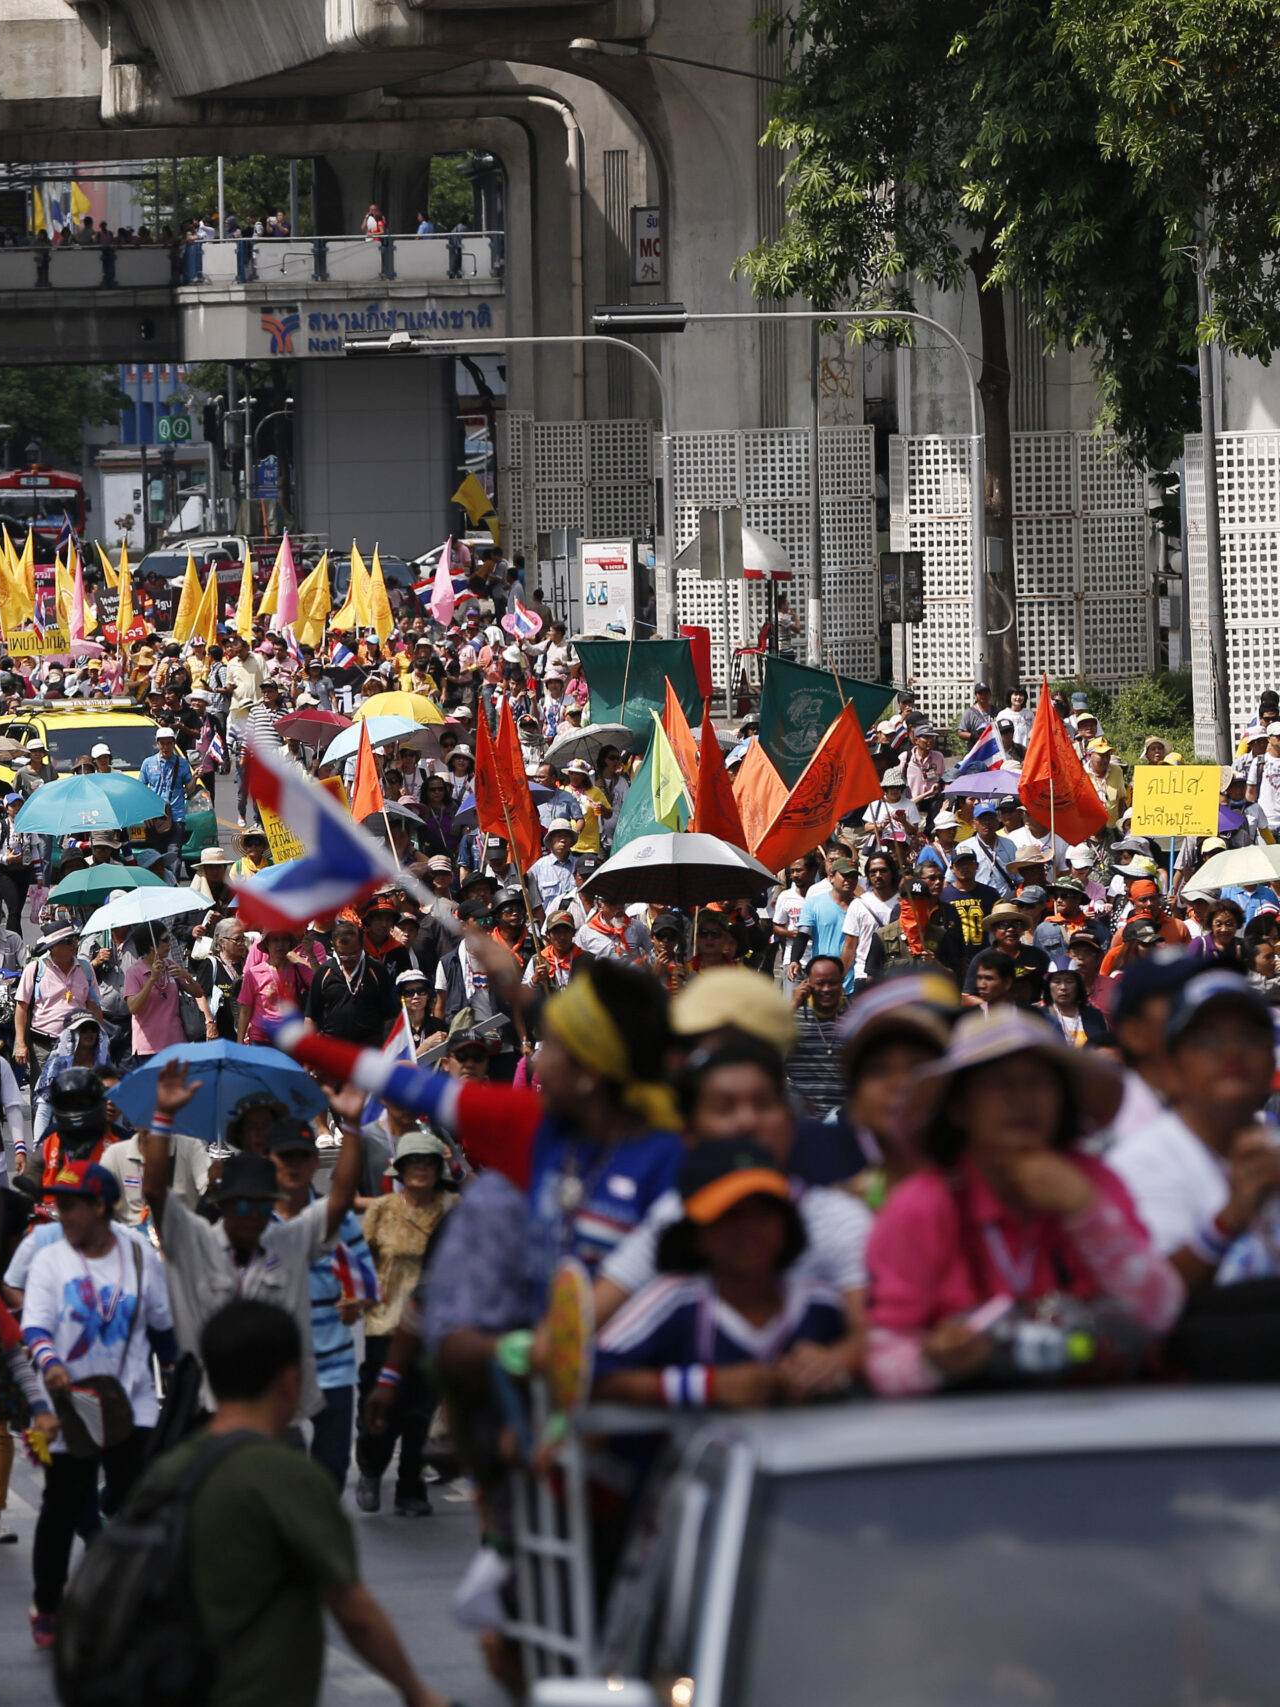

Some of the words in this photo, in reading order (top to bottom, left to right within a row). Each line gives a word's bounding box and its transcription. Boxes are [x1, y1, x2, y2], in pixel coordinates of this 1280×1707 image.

[308, 303, 492, 330] สนามกีฬาแห่งชาติ
